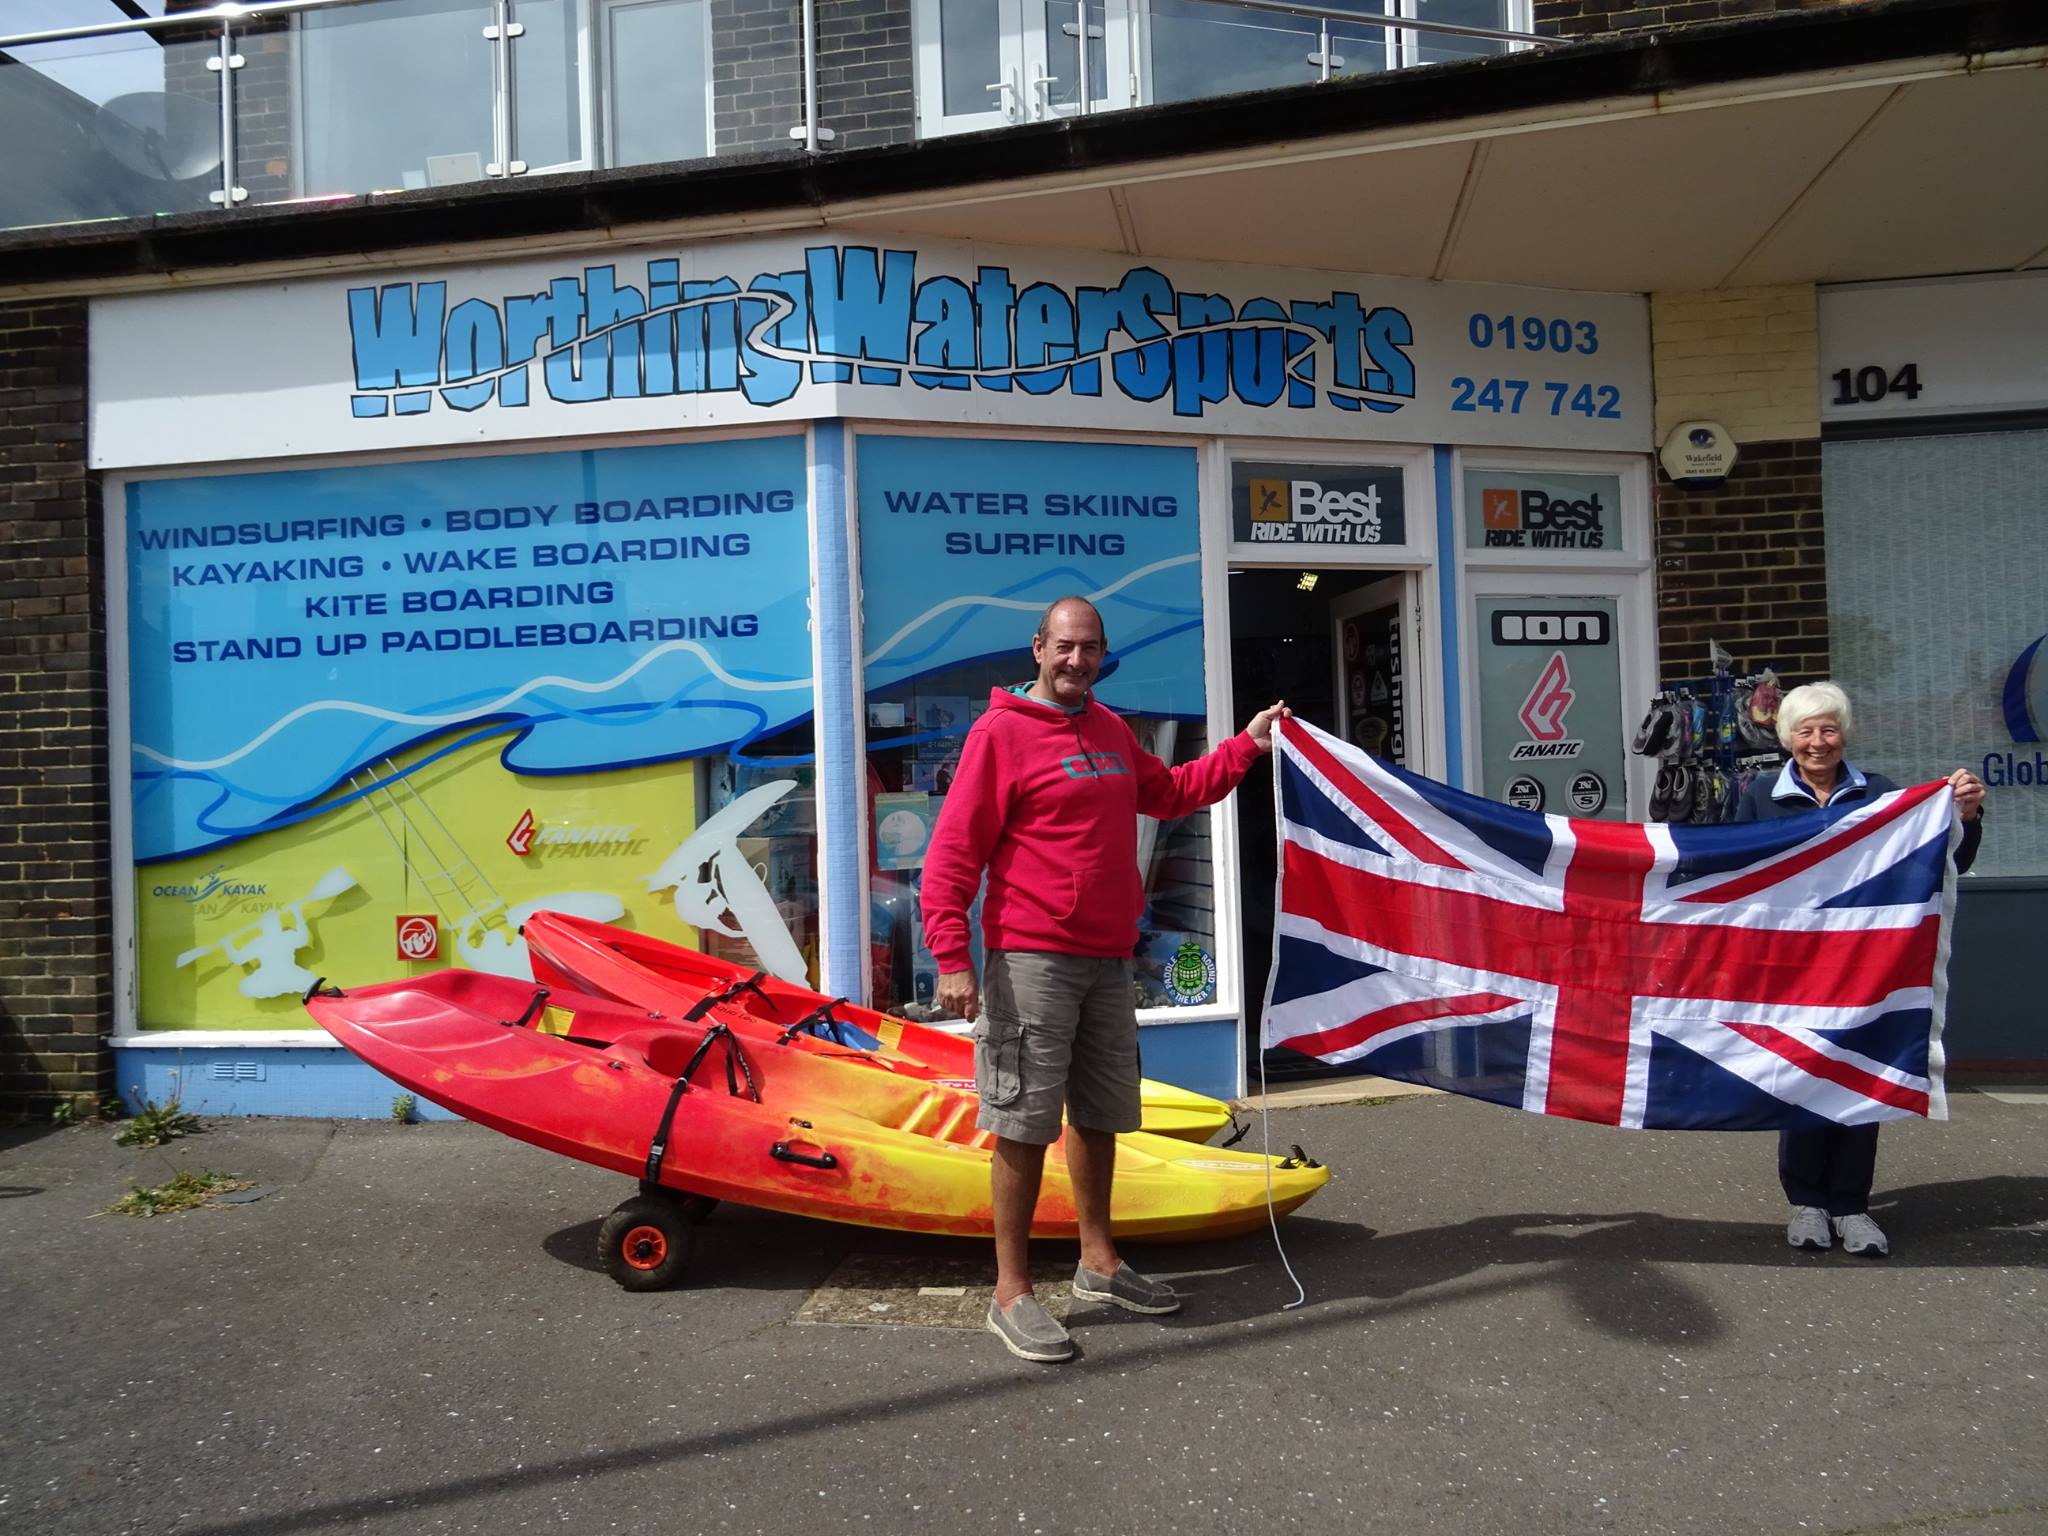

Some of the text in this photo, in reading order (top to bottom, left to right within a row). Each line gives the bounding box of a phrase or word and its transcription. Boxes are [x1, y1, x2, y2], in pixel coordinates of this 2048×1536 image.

[1468, 313, 1599, 355] 01903
[1451, 377, 1621, 418] 247 742
[1832, 363, 1923, 405] 104
[138, 490, 794, 550] WINDSURFING BODY BOARDING
[884, 491, 1178, 518] WATER SKIING
[1291, 480, 1382, 525] Best
[1521, 490, 1603, 531] Best
[945, 532, 1126, 556] SURFING
[1250, 522, 1382, 543] RIDE WITH US
[1485, 529, 1603, 549] RIDE WITH US
[173, 533, 751, 587] KAYAKING WAKE BOARDING
[305, 581, 614, 618] KITE BOARDING
[173, 614, 759, 663] STAND UP PADDLEBOARDING
[1389, 615, 1406, 767] tushing
[1513, 743, 1581, 758] FANATIC
[534, 825, 635, 846] FANATIC
[153, 884, 267, 897] OCEAN KAYAK
[1163, 955, 1178, 990] PADDLE
[1201, 953, 1216, 983] ROUND
[1175, 990, 1208, 1004] THE PIER
